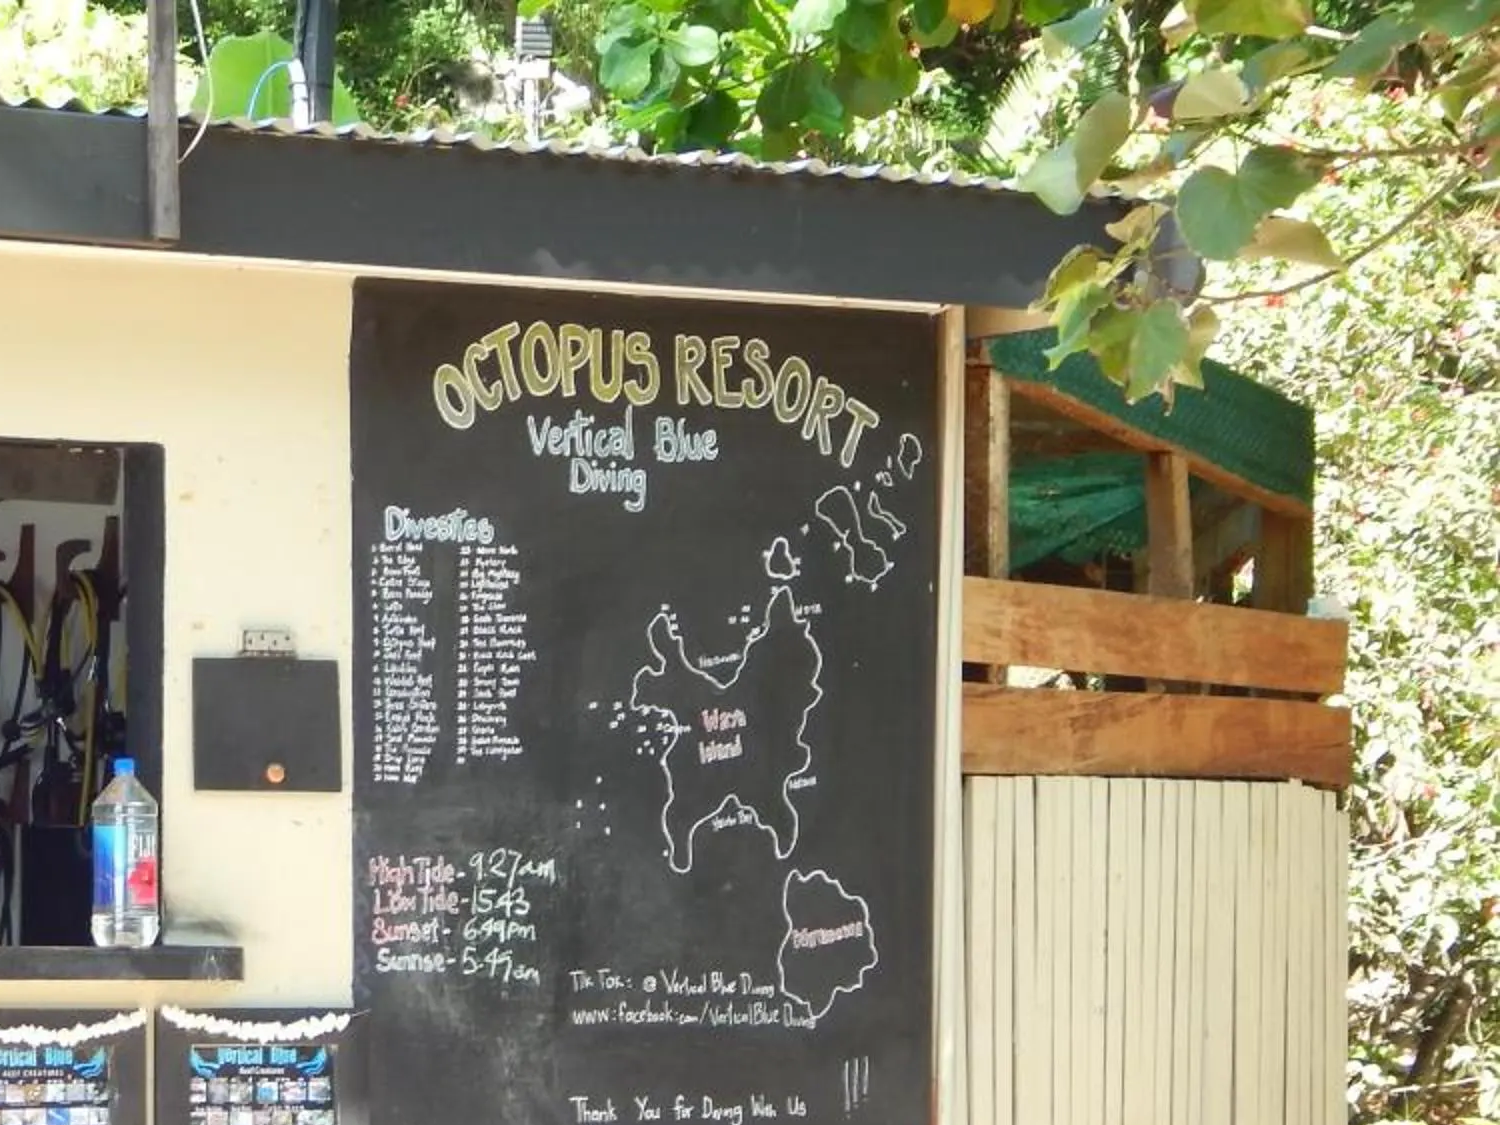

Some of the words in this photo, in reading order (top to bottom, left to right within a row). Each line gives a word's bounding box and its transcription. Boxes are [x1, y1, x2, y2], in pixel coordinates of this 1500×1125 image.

[433, 320, 661, 430] OCTOPUS
[675, 333, 881, 468] RESORT
[527, 403, 636, 461] Vertical
[653, 416, 719, 463] Blue
[569, 457, 648, 513] Diving
[699, 734, 743, 764] Island
[369, 854, 414, 888] High
[711, 971, 737, 994] Blue
[568, 1095, 619, 1124] Thank
[634, 1095, 661, 1122] You
[672, 1093, 695, 1122] for
[750, 1094, 777, 1119] With
[787, 1095, 808, 1117] Us
